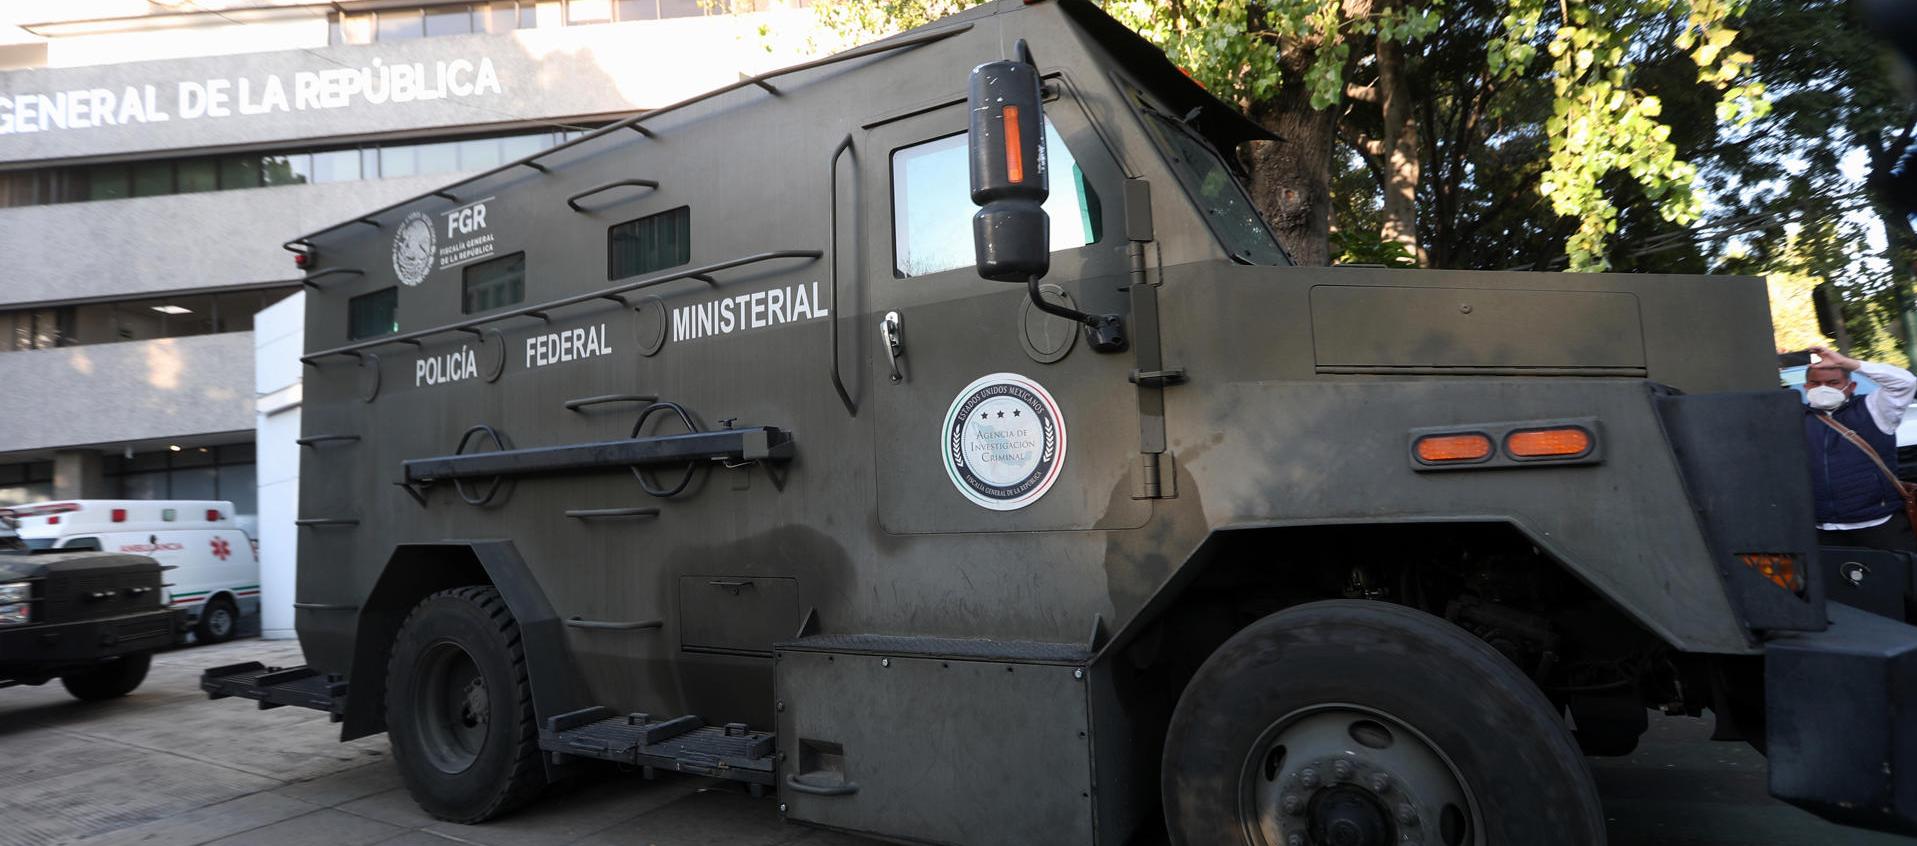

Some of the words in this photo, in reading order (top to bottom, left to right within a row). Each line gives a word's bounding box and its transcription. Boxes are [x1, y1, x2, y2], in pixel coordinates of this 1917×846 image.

[0, 85, 170, 135] GENERAL
[178, 78, 232, 119] DE
[238, 75, 291, 116] LA
[295, 57, 501, 110] REPÚBLICA
[448, 204, 486, 238] FGR
[466, 234, 494, 247] GENERAL
[440, 256, 449, 265] DE
[450, 254, 458, 263] LA
[416, 344, 478, 388] POLICÍA
[526, 323, 613, 369] FEDERAL
[673, 281, 829, 343] MINISTERIAL
[959, 395, 981, 421] ESTADOS
[981, 386, 1008, 398] UNIDOS
[1009, 386, 1045, 415] MEXICANOS
[985, 487, 1006, 497] GENERAL
